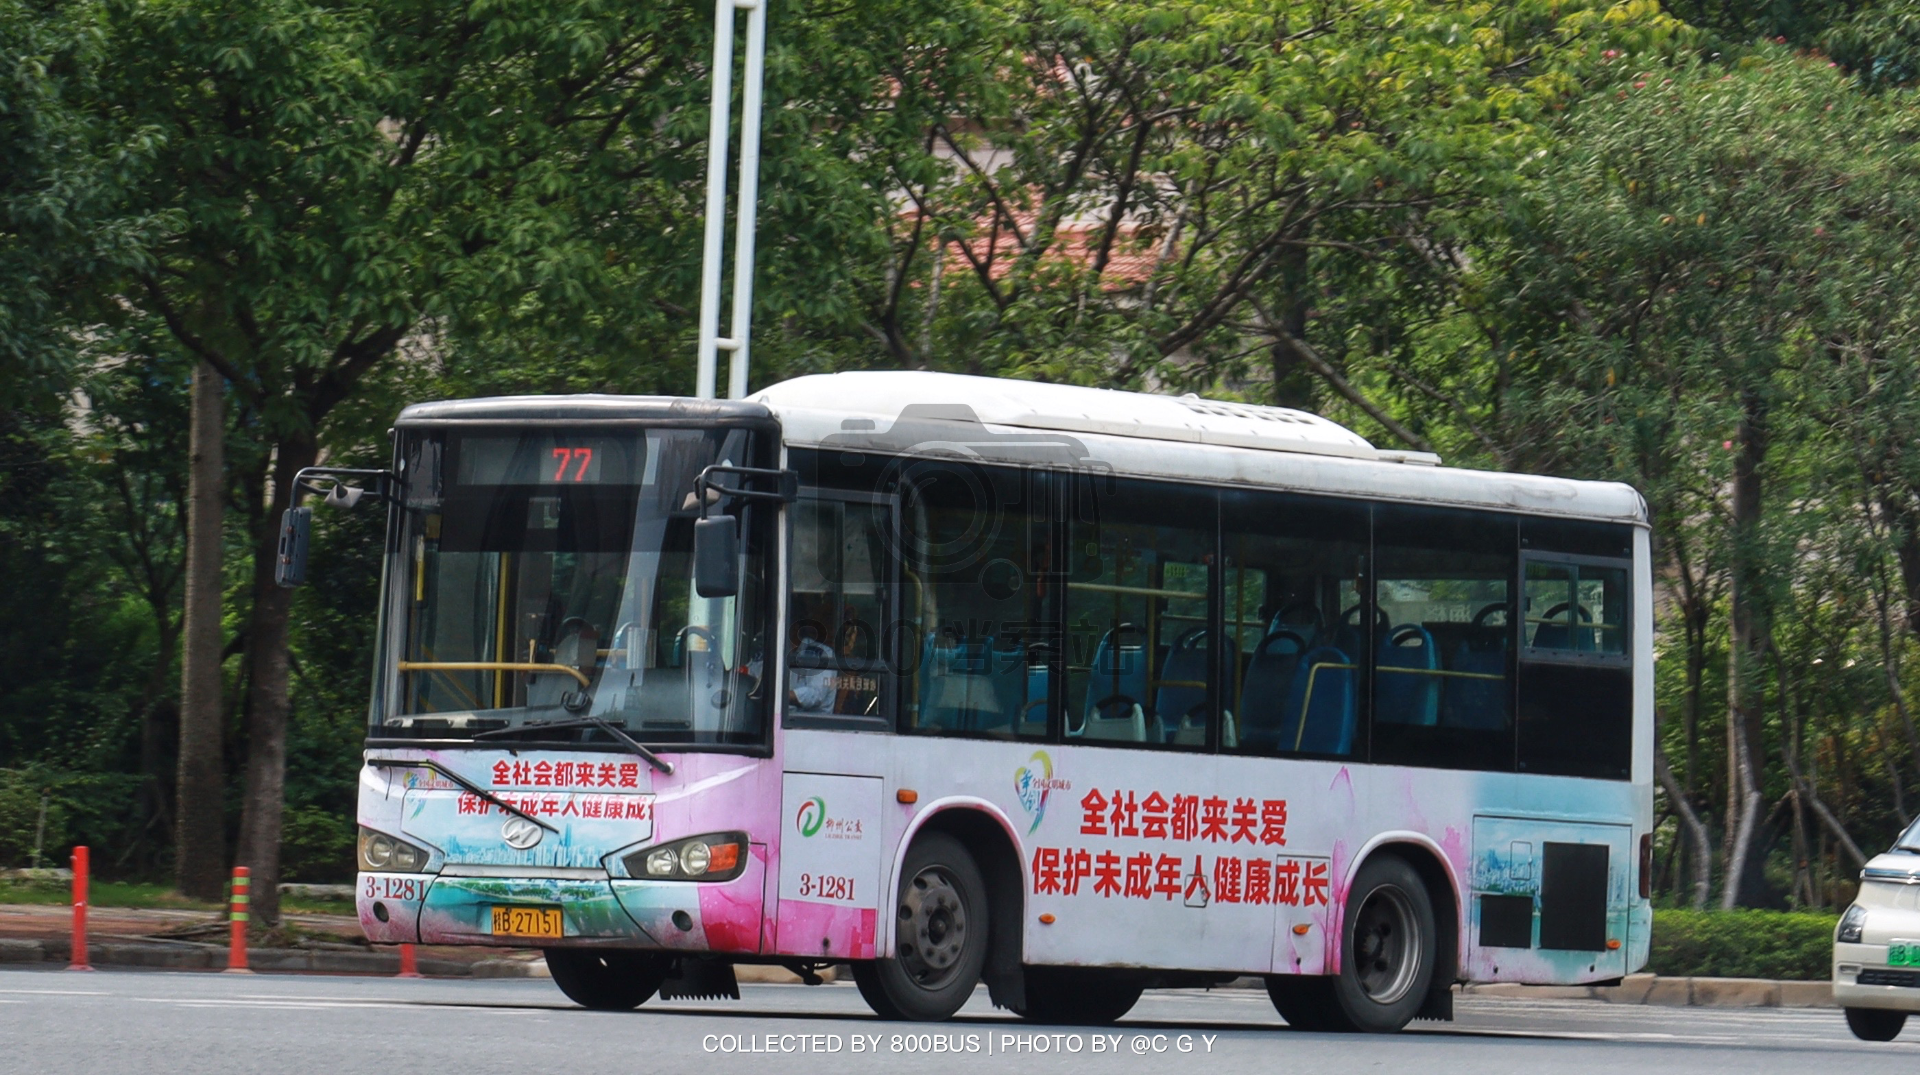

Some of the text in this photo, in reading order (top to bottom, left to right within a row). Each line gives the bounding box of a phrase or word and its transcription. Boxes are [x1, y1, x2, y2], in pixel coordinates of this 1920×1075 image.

[552, 447, 592, 482] 77
[492, 760, 639, 788] 全社会都来关爱
[1080, 788, 1288, 846] 全社会都来关爱
[365, 875, 426, 902] 3-1281
[799, 873, 855, 900] 3-1281
[1032, 847, 1329, 907] 保护未成年人健康成长
